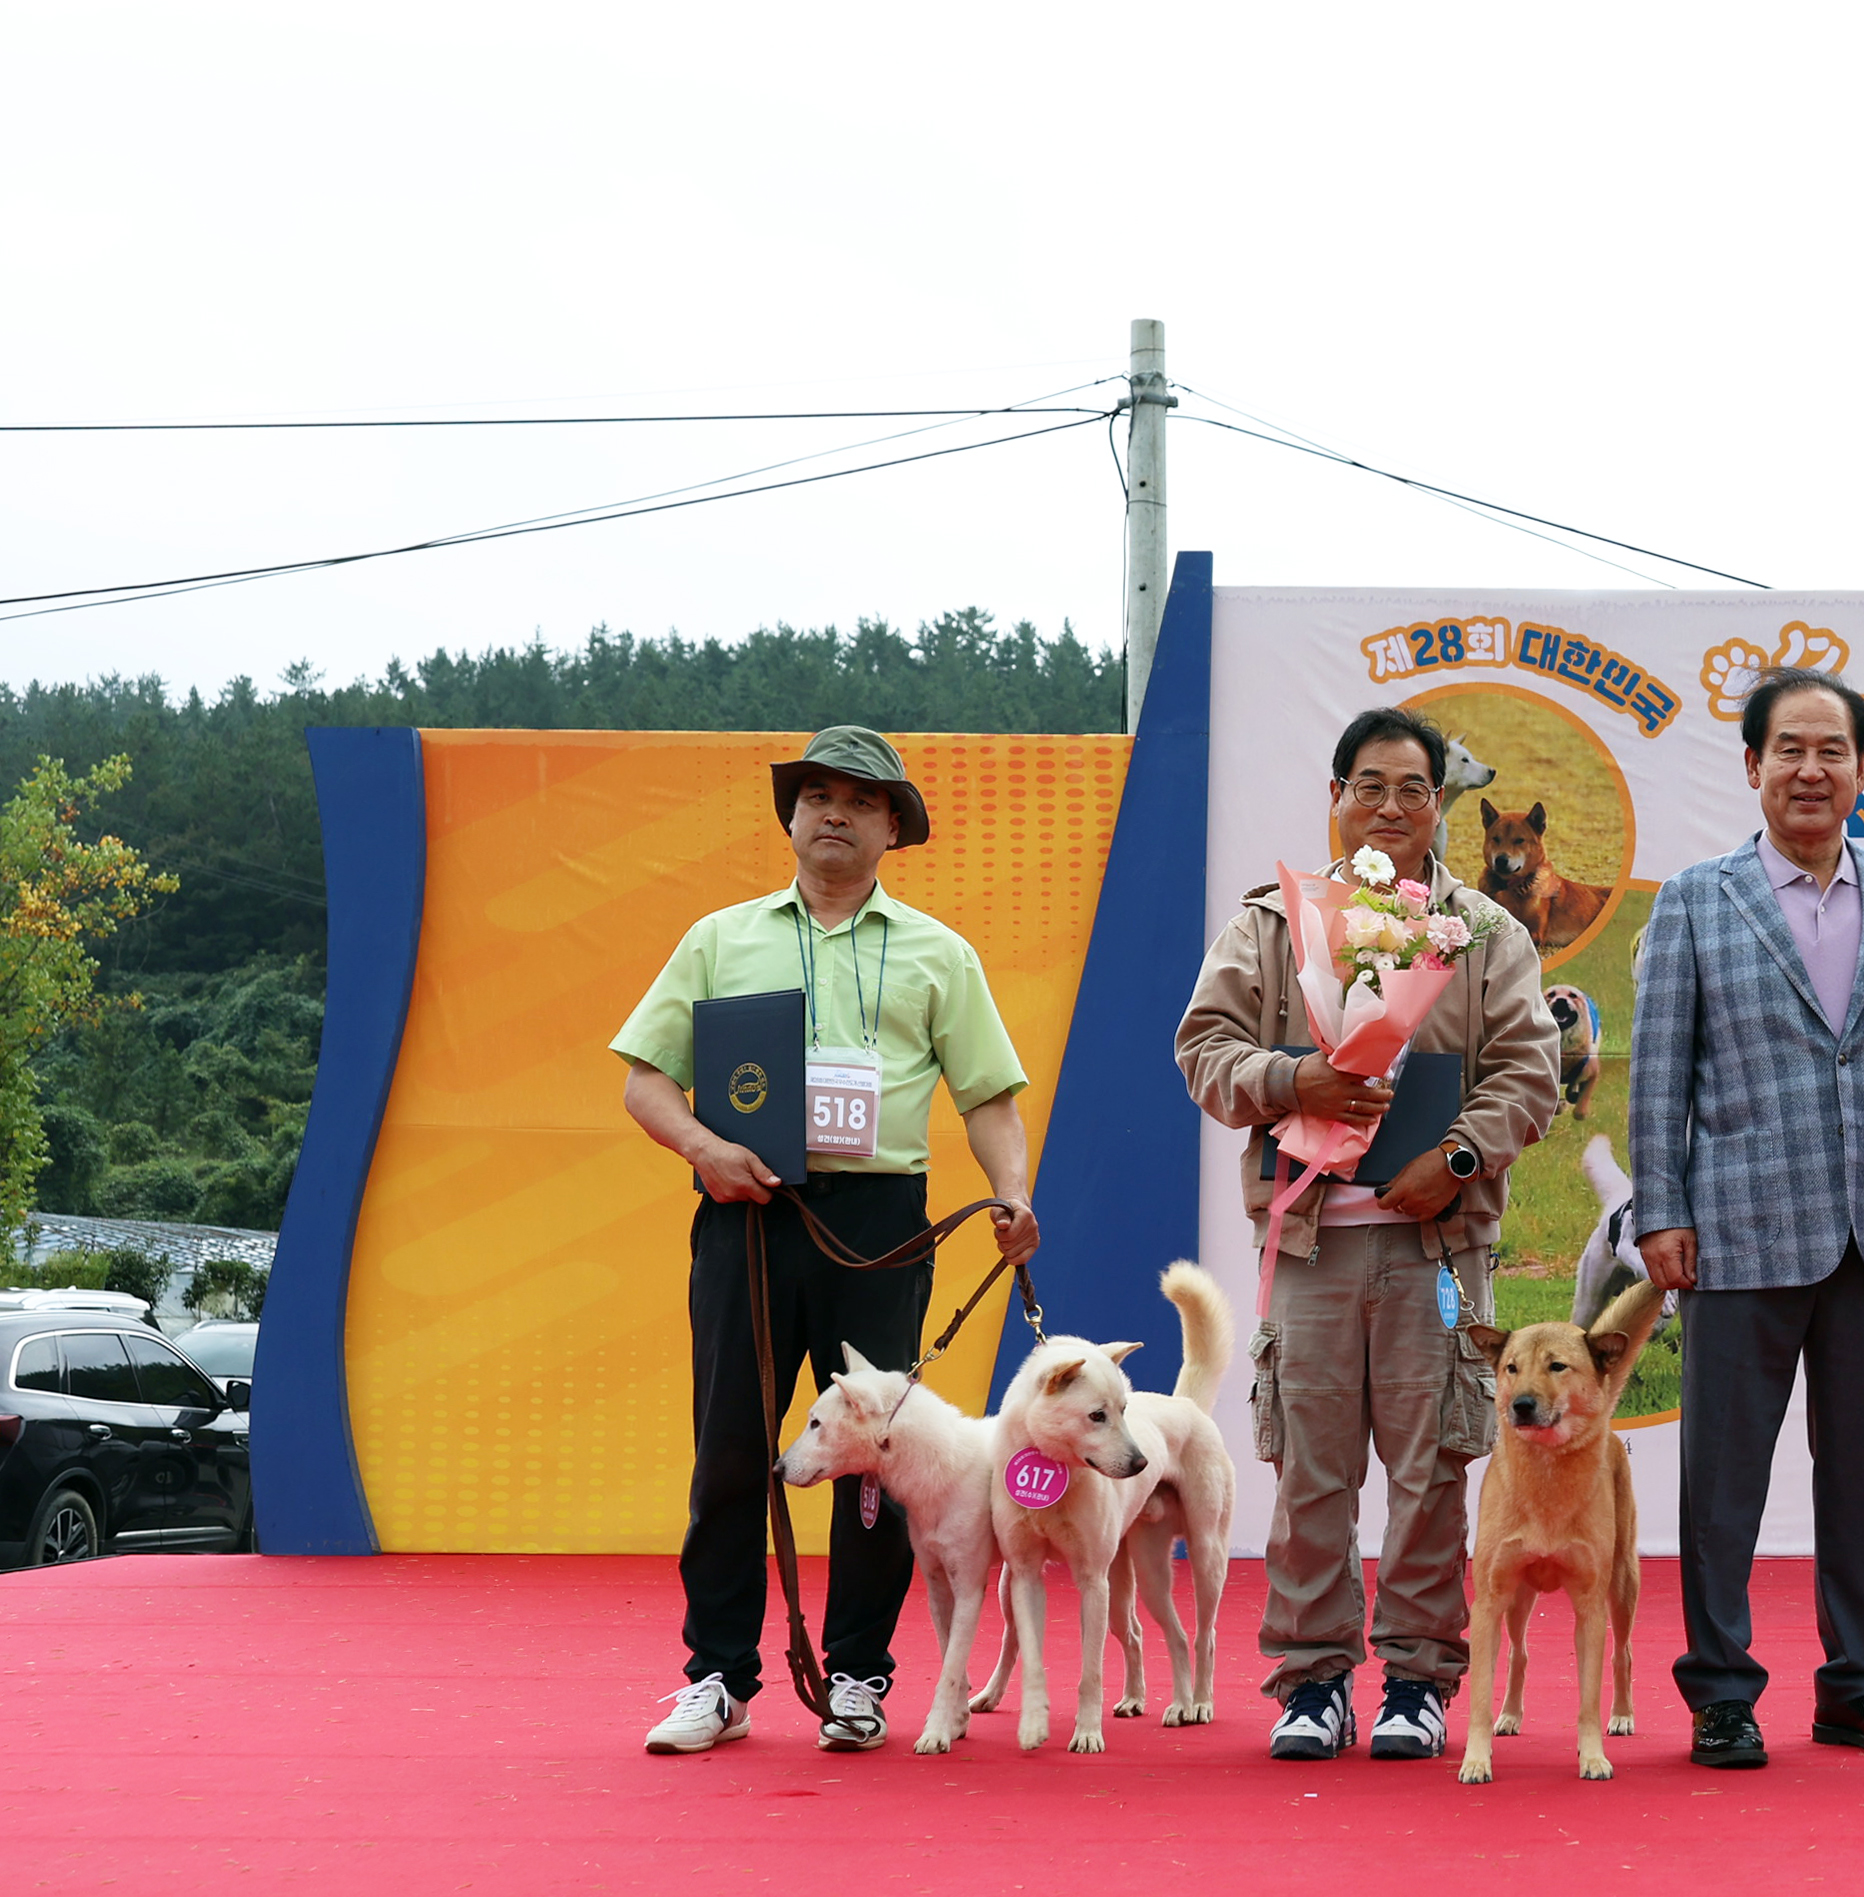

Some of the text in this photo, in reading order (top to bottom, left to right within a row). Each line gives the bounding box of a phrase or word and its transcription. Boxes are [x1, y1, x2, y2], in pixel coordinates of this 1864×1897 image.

[1366, 621, 1676, 732] 제28회 대한민국
[812, 1095, 867, 1131] 518
[1440, 1287, 1456, 1310] 728
[1015, 1464, 1056, 1491] 617
[863, 1486, 876, 1510] 518
